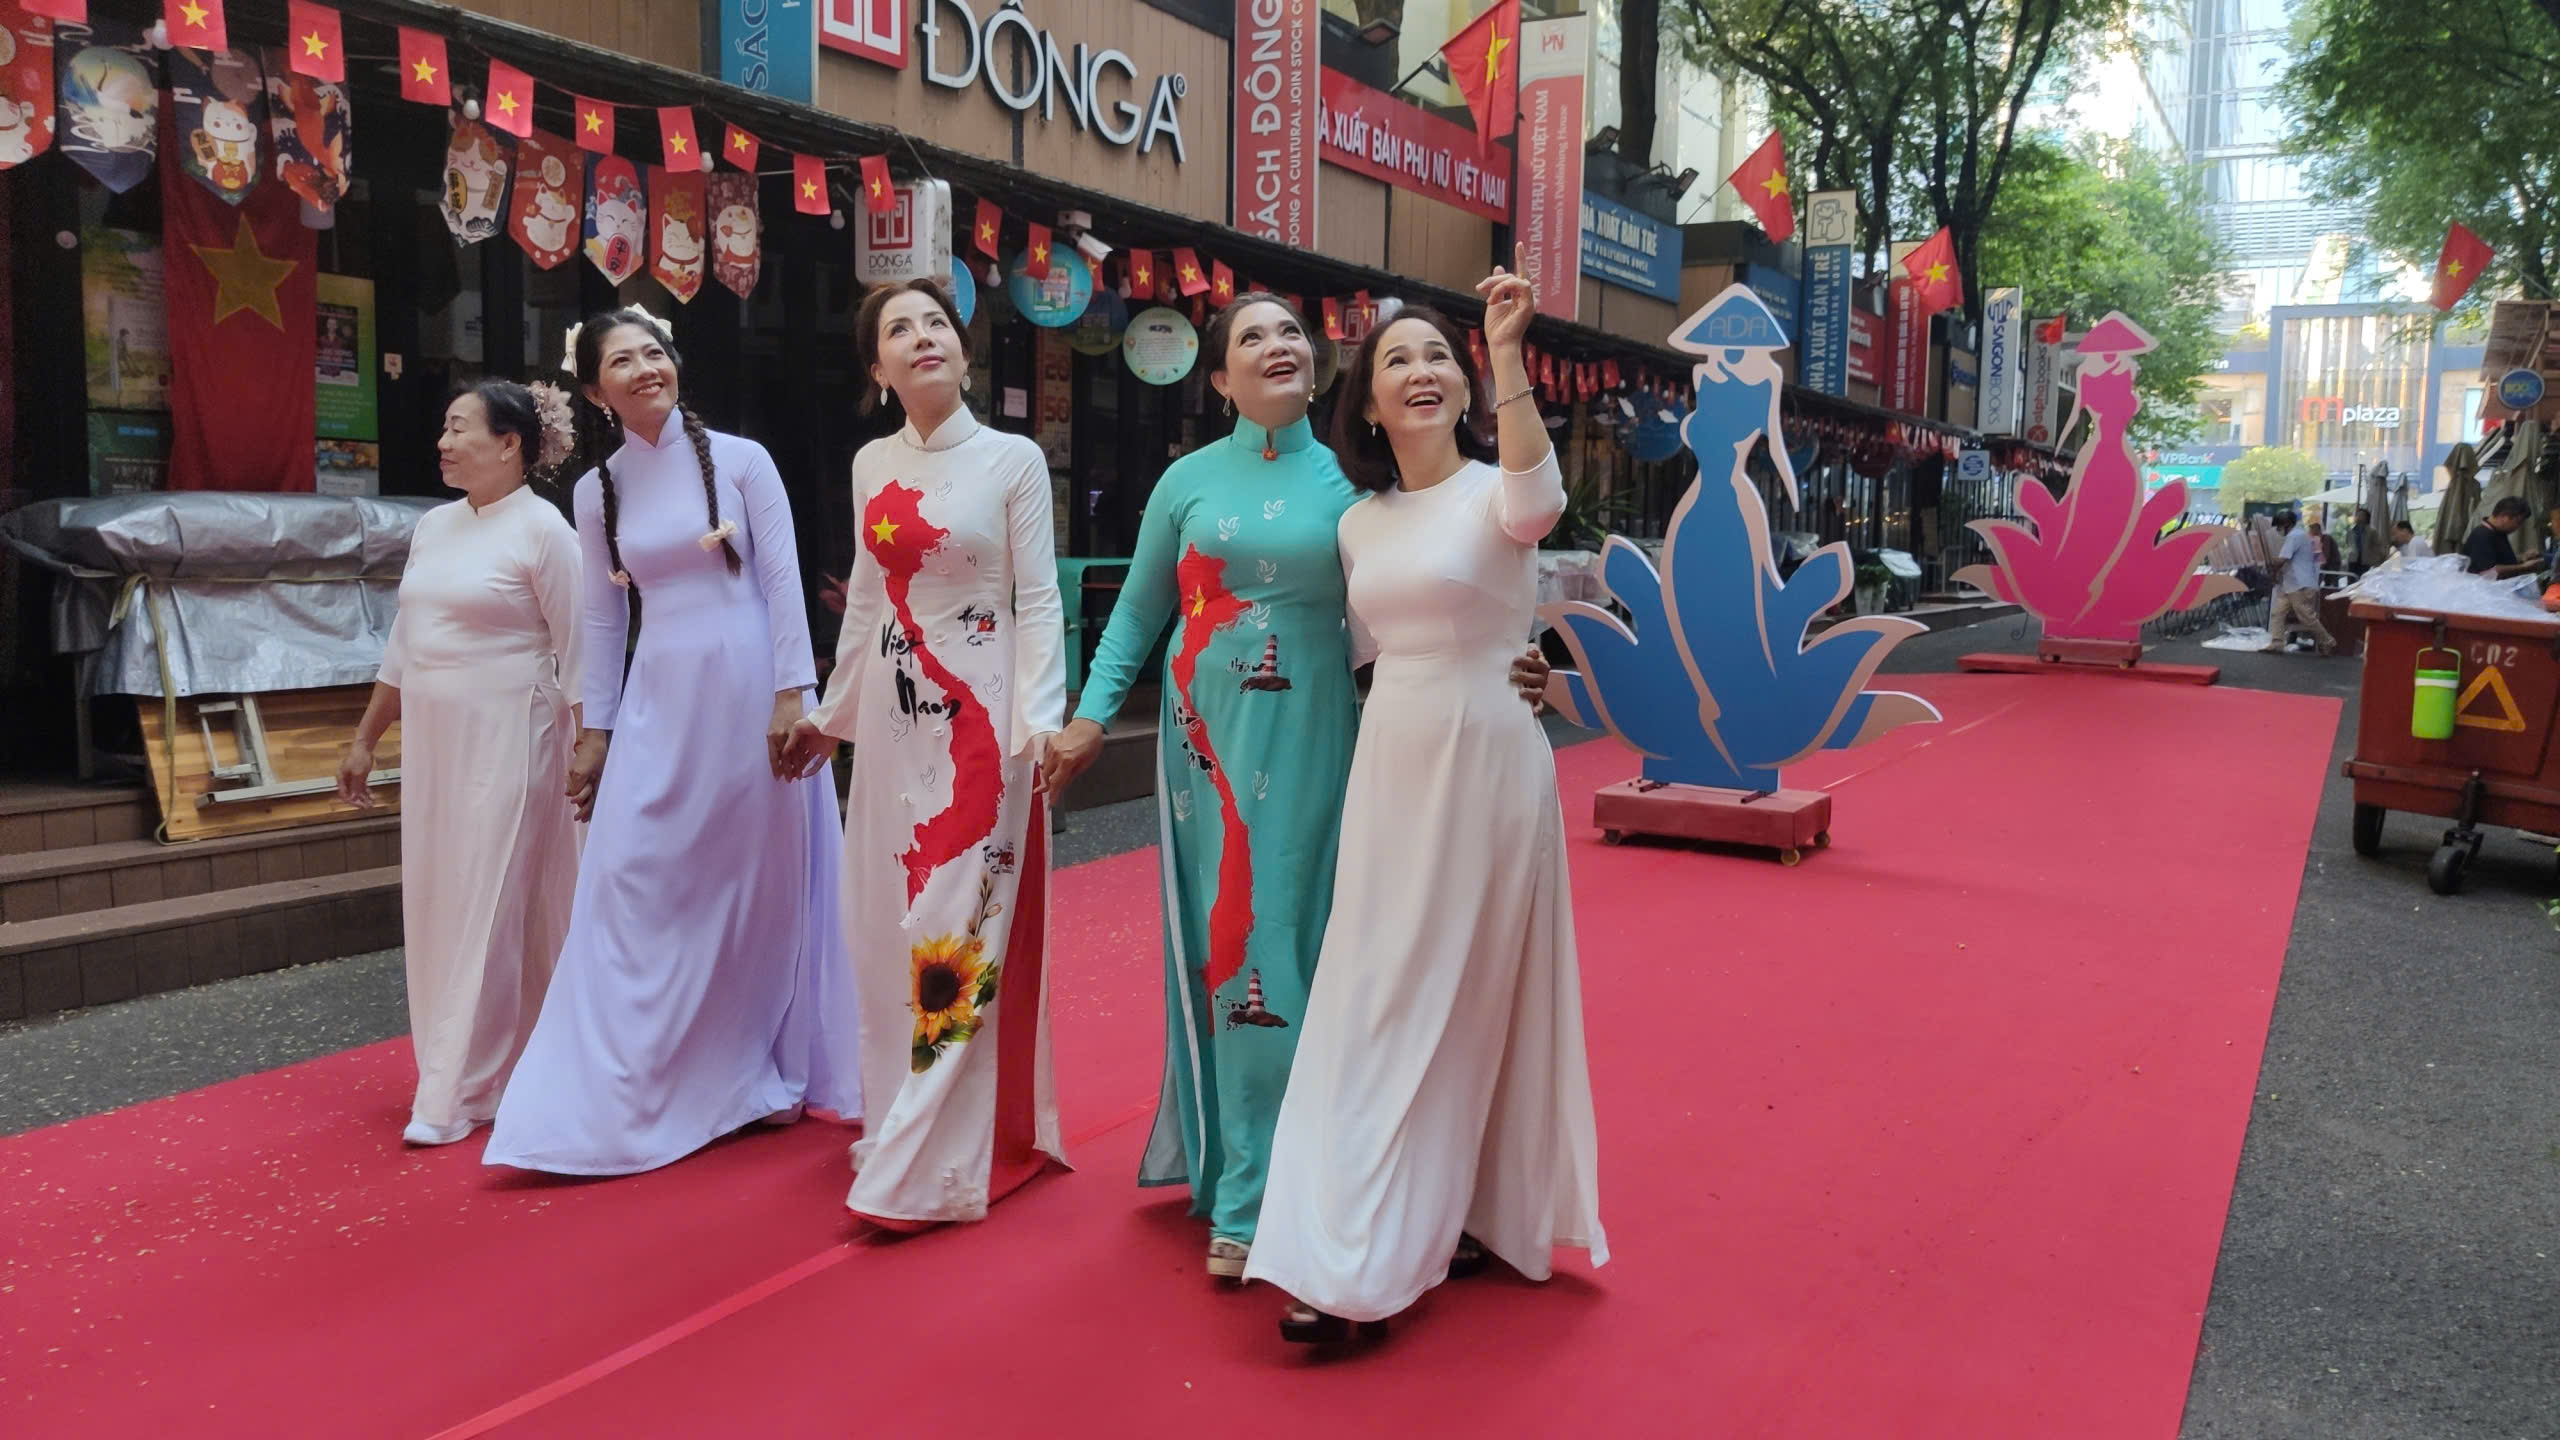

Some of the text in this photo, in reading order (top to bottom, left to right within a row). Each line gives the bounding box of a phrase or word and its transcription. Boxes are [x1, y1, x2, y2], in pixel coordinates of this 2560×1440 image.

[1291, 0, 1304, 15] C
[1291, 18, 1303, 70] STOCK
[1290, 71, 1302, 106] JOIN
[1536, 90, 1549, 122] NAM
[1289, 112, 1302, 180] CULTURAL
[1533, 124, 1549, 155] VIỆT
[1333, 105, 1369, 157] XUẤT
[1372, 119, 1401, 170] BẢN
[1403, 140, 1431, 186] PHỤ
[1432, 149, 1451, 188] NỮ
[1454, 157, 1479, 201] VIỆT
[1481, 172, 1506, 208] NAM
[1289, 184, 1301, 195] A
[1708, 313, 1768, 339] ADA
[1806, 251, 1830, 393] NHÀ XUẤT BẢN TRẺ
